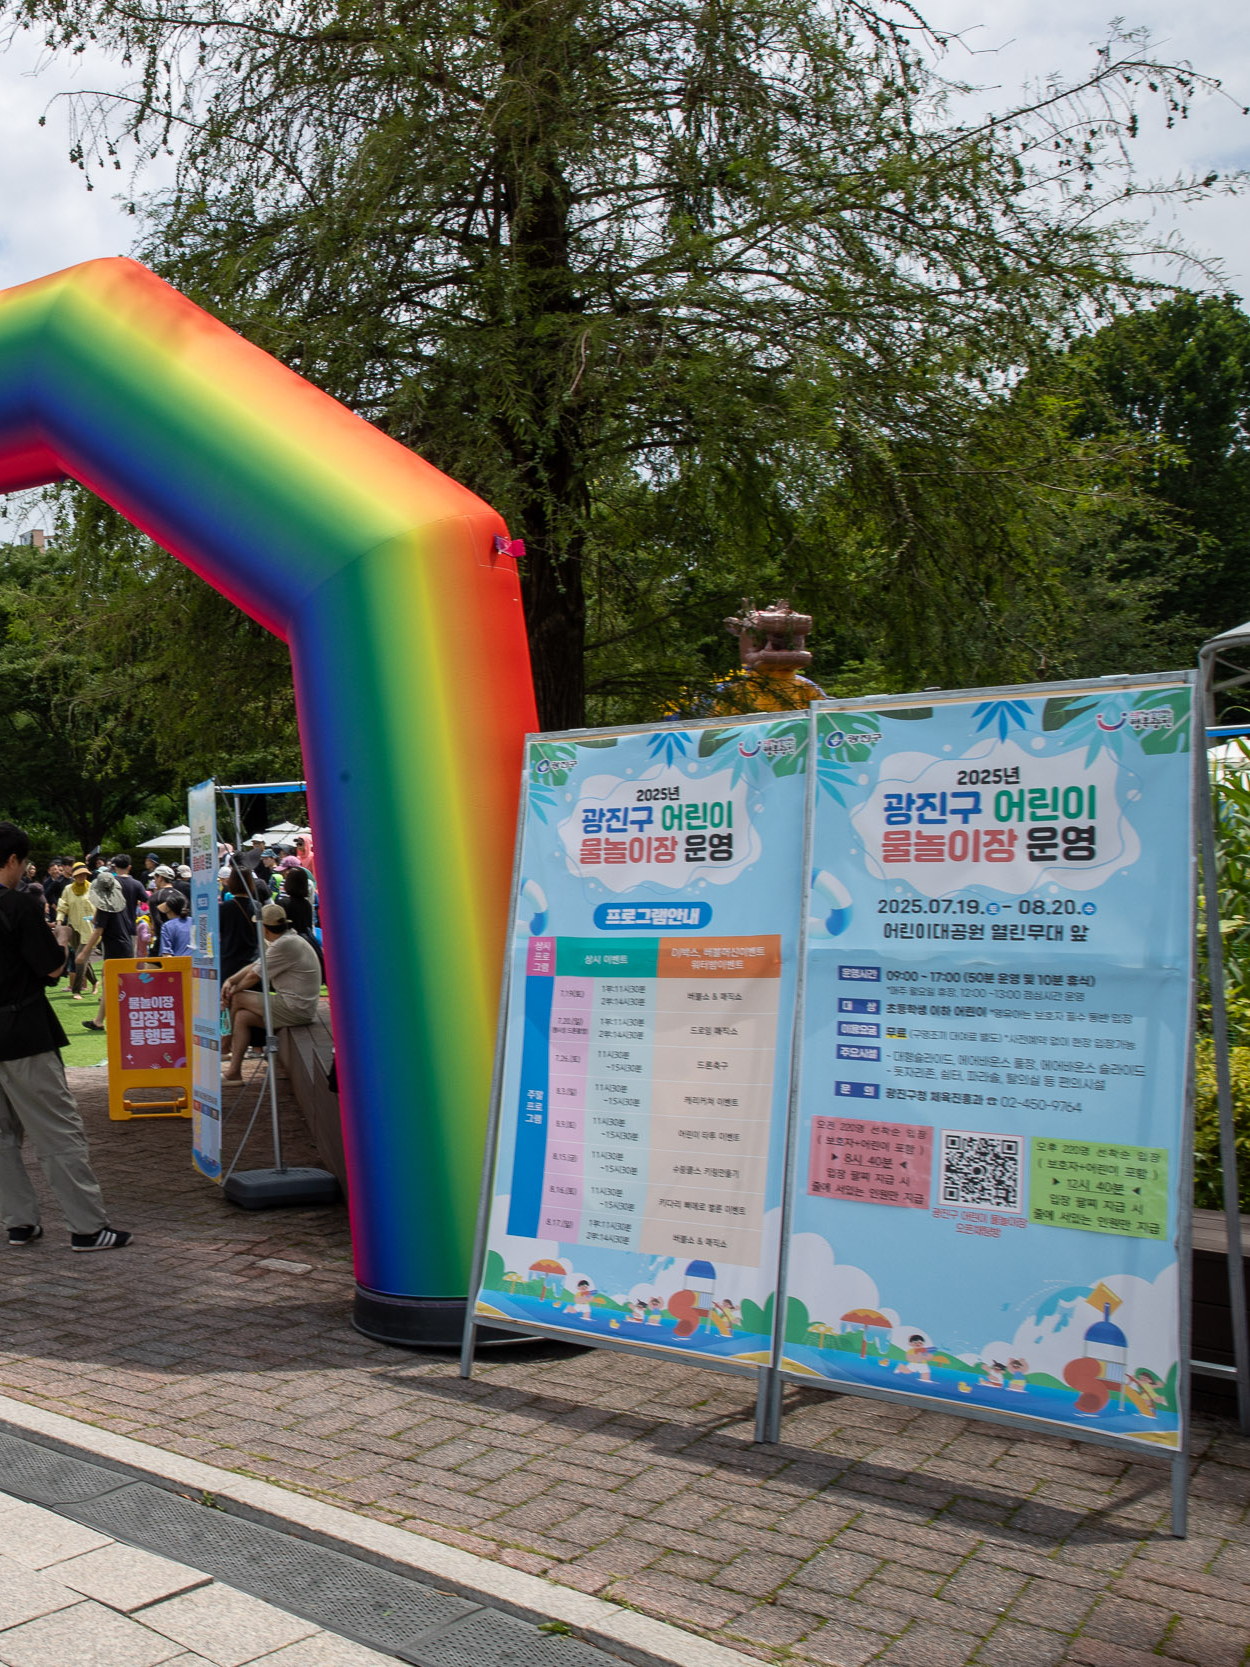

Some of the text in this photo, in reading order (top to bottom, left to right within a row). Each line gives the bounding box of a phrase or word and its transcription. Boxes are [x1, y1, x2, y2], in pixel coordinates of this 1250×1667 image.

[846, 733, 883, 745] 광진구
[551, 760, 577, 770] 광진구
[957, 767, 1021, 786] 2025년
[636, 786, 680, 802] 2025년
[883, 785, 1096, 826] 광진구 어린이
[581, 800, 733, 834] 광진구 어린이
[579, 832, 734, 865] 물놀이장 운영
[881, 826, 1096, 864] 물놀이장 운영
[605, 908, 701, 926] 프로그램안내
[883, 923, 1090, 943] 어린이대공원 열린무대 앞
[534, 941, 551, 950] 상시
[534, 952, 550, 961] 프로
[584, 955, 629, 965] 상시 이벤트
[533, 962, 549, 973] 그램
[841, 968, 878, 980] 운영시간
[886, 971, 1096, 987] 09:00 17:00 (50분 운영 및 10분 휴식)
[128, 996, 174, 1010] 물놀이장
[909, 986, 935, 997] 월요일
[960, 988, 987, 998] 12:00
[1023, 991, 1063, 1001] 점심시간
[1064, 991, 1085, 1002] 운영
[128, 1010, 175, 1028] 입장객
[886, 1003, 928, 1016] 초등학생
[929, 1005, 952, 1016] 이하
[954, 1006, 987, 1018] 어린이
[1034, 1010, 1064, 1021] 보호자
[1066, 1011, 1086, 1022] 필수
[1088, 1012, 1108, 1023] 동반
[1111, 1013, 1134, 1024] 입장
[130, 1028, 176, 1046] 통행로
[841, 1023, 878, 1036] 이용요금
[886, 1027, 907, 1038] 무료
[979, 1032, 1003, 1043] 별도)
[1050, 1036, 1070, 1047] 없이
[1072, 1037, 1093, 1048] 현장
[1095, 1038, 1136, 1050] 입장가능
[840, 1046, 878, 1060] 주요시설
[957, 1054, 1011, 1068] 에어바운스
[1040, 1059, 1096, 1074] 에어바운스
[1099, 1063, 1147, 1077] 슬라이드
[1006, 1073, 1040, 1087] 탈의실
[1043, 1076, 1055, 1088] 등
[1058, 1077, 1106, 1091] 편의시설
[527, 1089, 544, 1101] 주말
[716, 1097, 739, 1107] 이벤트
[885, 1087, 1083, 1113] 광진구청 체육진흥과 02-450-9764
[525, 1101, 543, 1111] 프로
[524, 1113, 543, 1125] 그램
[719, 1132, 741, 1142] 이벤트
[817, 1120, 926, 1140] 오전 220명 선착순 입장
[826, 1136, 916, 1155] 보호자+어린이 포함
[1036, 1141, 1161, 1163] 오후 220명 선착순 입장
[844, 1153, 894, 1169] 8시 40분
[1046, 1159, 1148, 1180] 보호자+어린이 포함
[827, 1168, 846, 1180] 입장
[875, 1173, 895, 1185] 지급
[835, 1184, 865, 1198] 서있는
[869, 1188, 899, 1202] 인원만
[903, 1192, 924, 1205] 지급
[1066, 1178, 1125, 1196] 12시 40분
[658, 1198, 747, 1216] 키다리 이벤트
[1049, 1193, 1071, 1207] 입장
[1103, 1200, 1126, 1213] 지급
[932, 1207, 1029, 1229] 광진구 어린이 물놀이장
[1060, 1212, 1093, 1226] 서있는
[1096, 1216, 1132, 1231] 인원만
[1136, 1221, 1160, 1235] 지급
